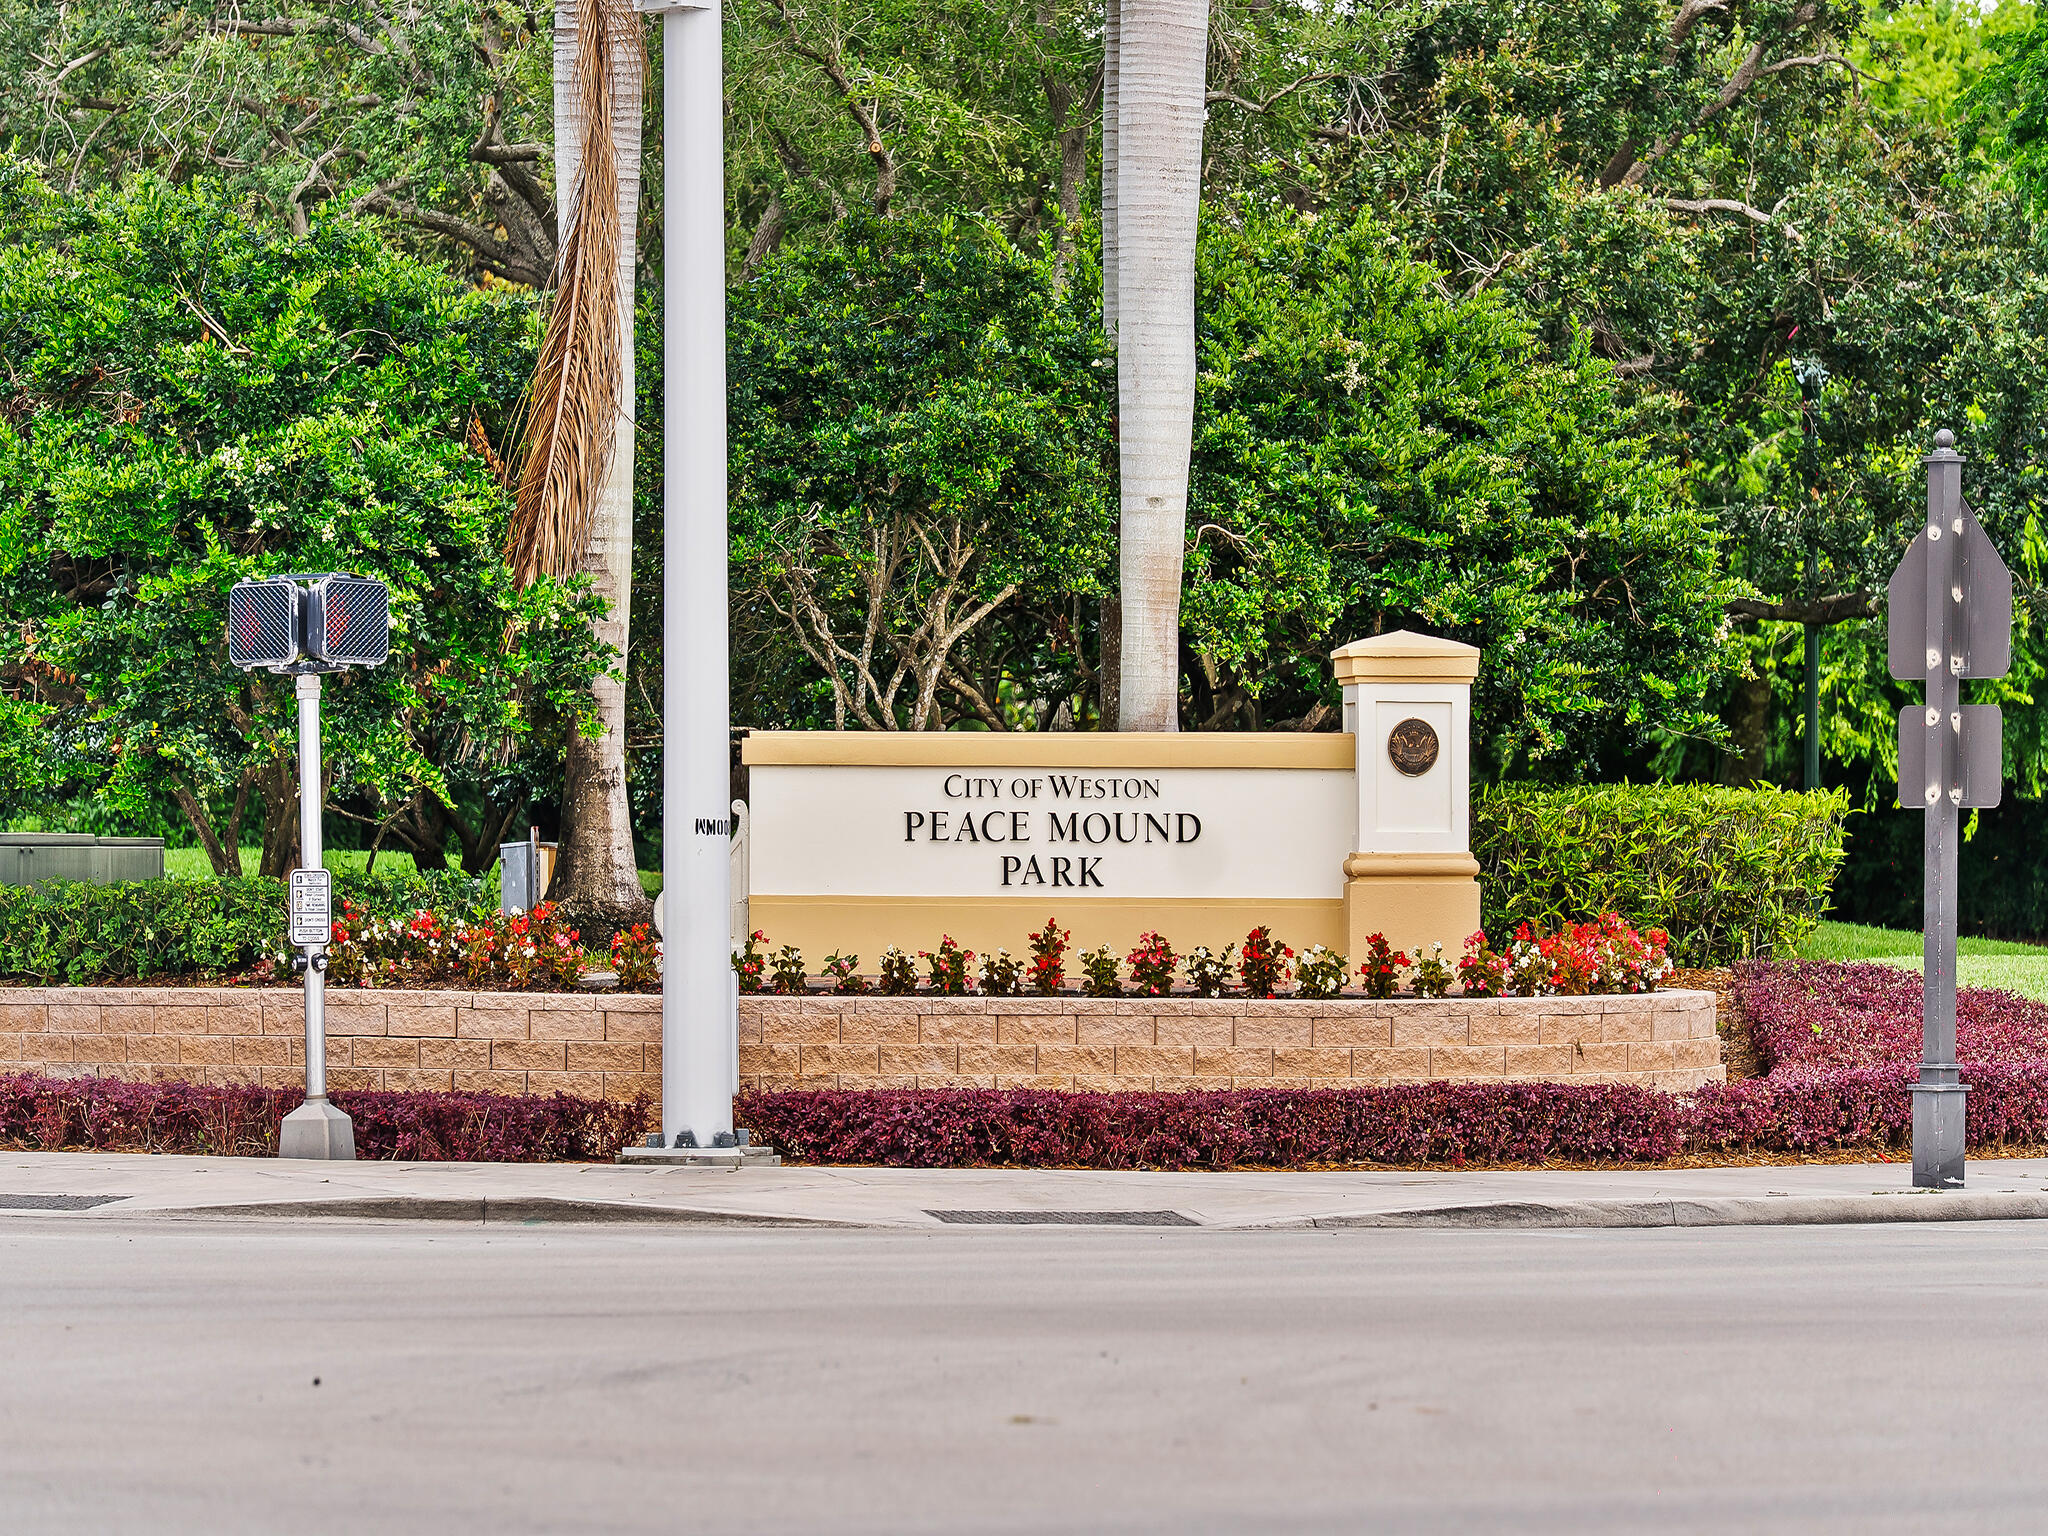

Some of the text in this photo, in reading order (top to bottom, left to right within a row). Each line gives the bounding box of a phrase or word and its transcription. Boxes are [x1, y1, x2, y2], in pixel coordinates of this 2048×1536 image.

[944, 774, 1160, 799] CITY OF WESTON
[904, 811, 1202, 843] PEACE MOUND
[1000, 854, 1104, 887] PARK
